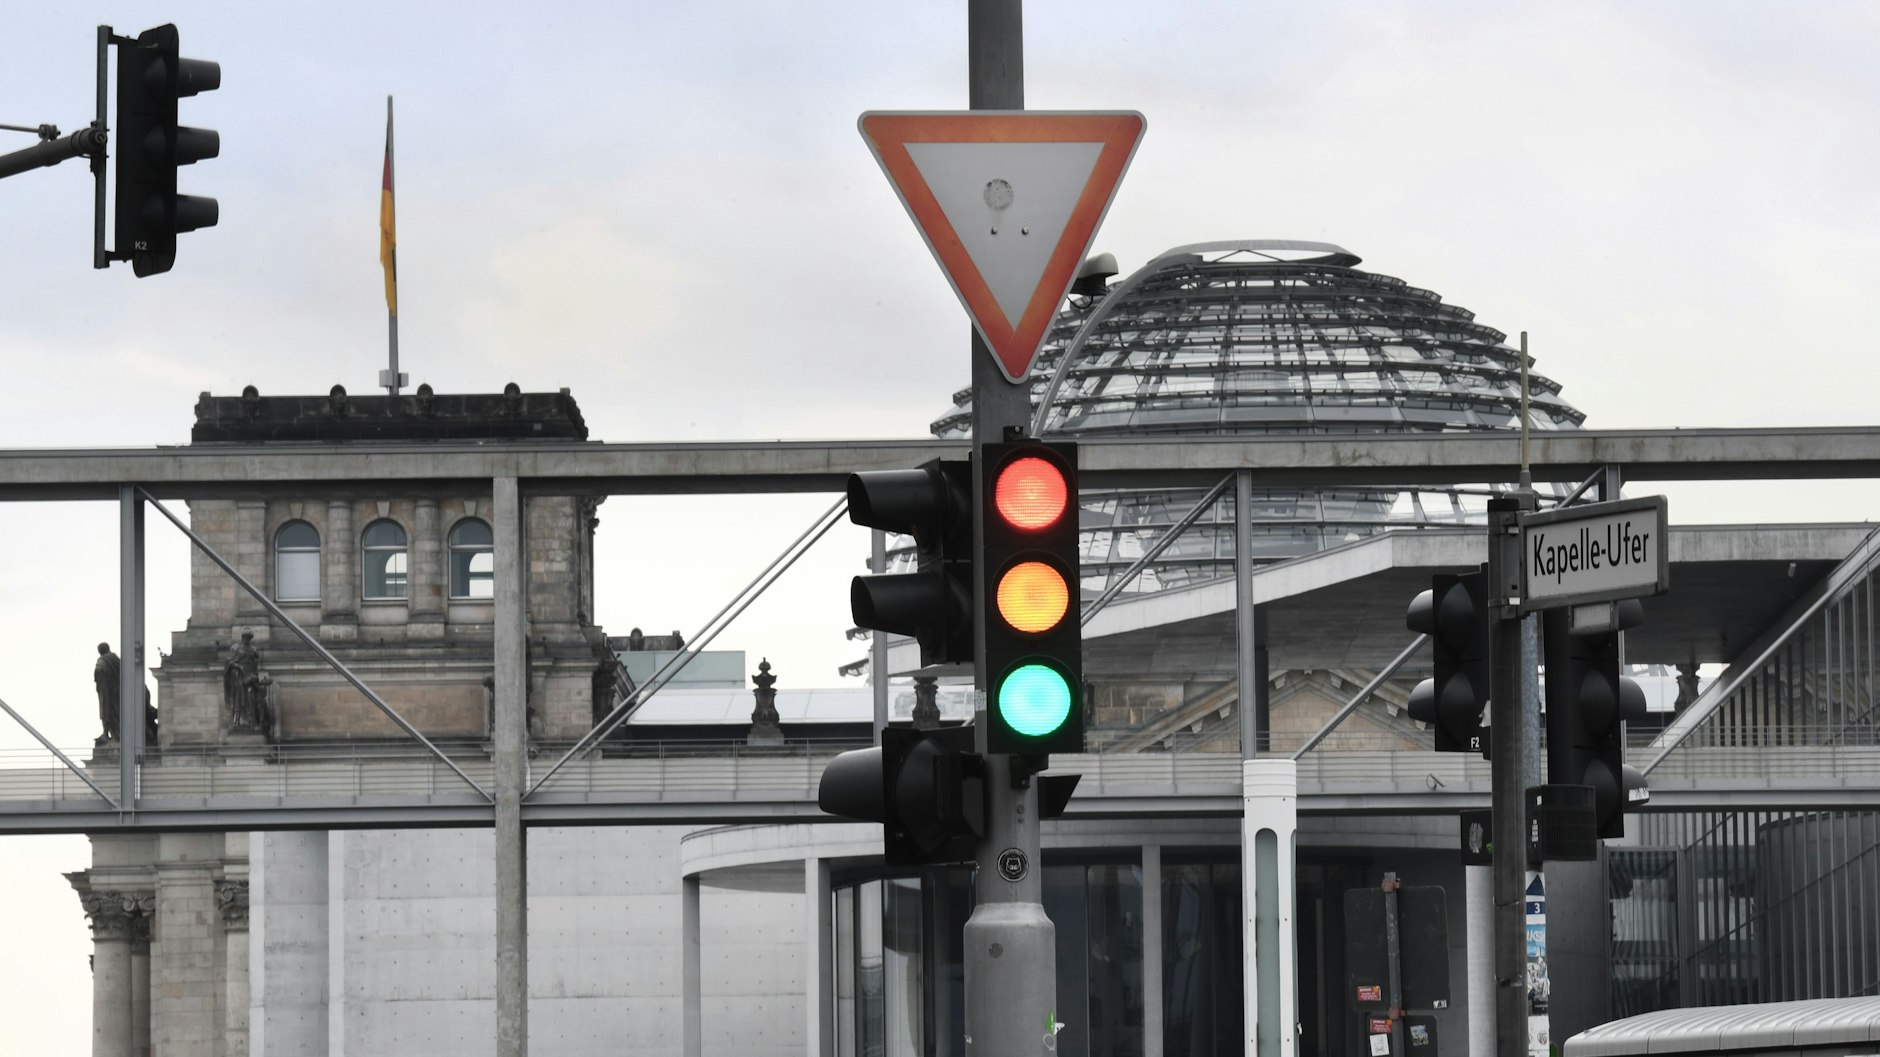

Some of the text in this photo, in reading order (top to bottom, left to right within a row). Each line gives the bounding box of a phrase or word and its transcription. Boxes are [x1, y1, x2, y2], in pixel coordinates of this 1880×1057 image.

[135, 240, 147, 250] K2
[1534, 521, 1649, 584] Kapelle-Ufer
[1470, 736, 1480, 749] F2
[1534, 902, 1541, 914] 3
